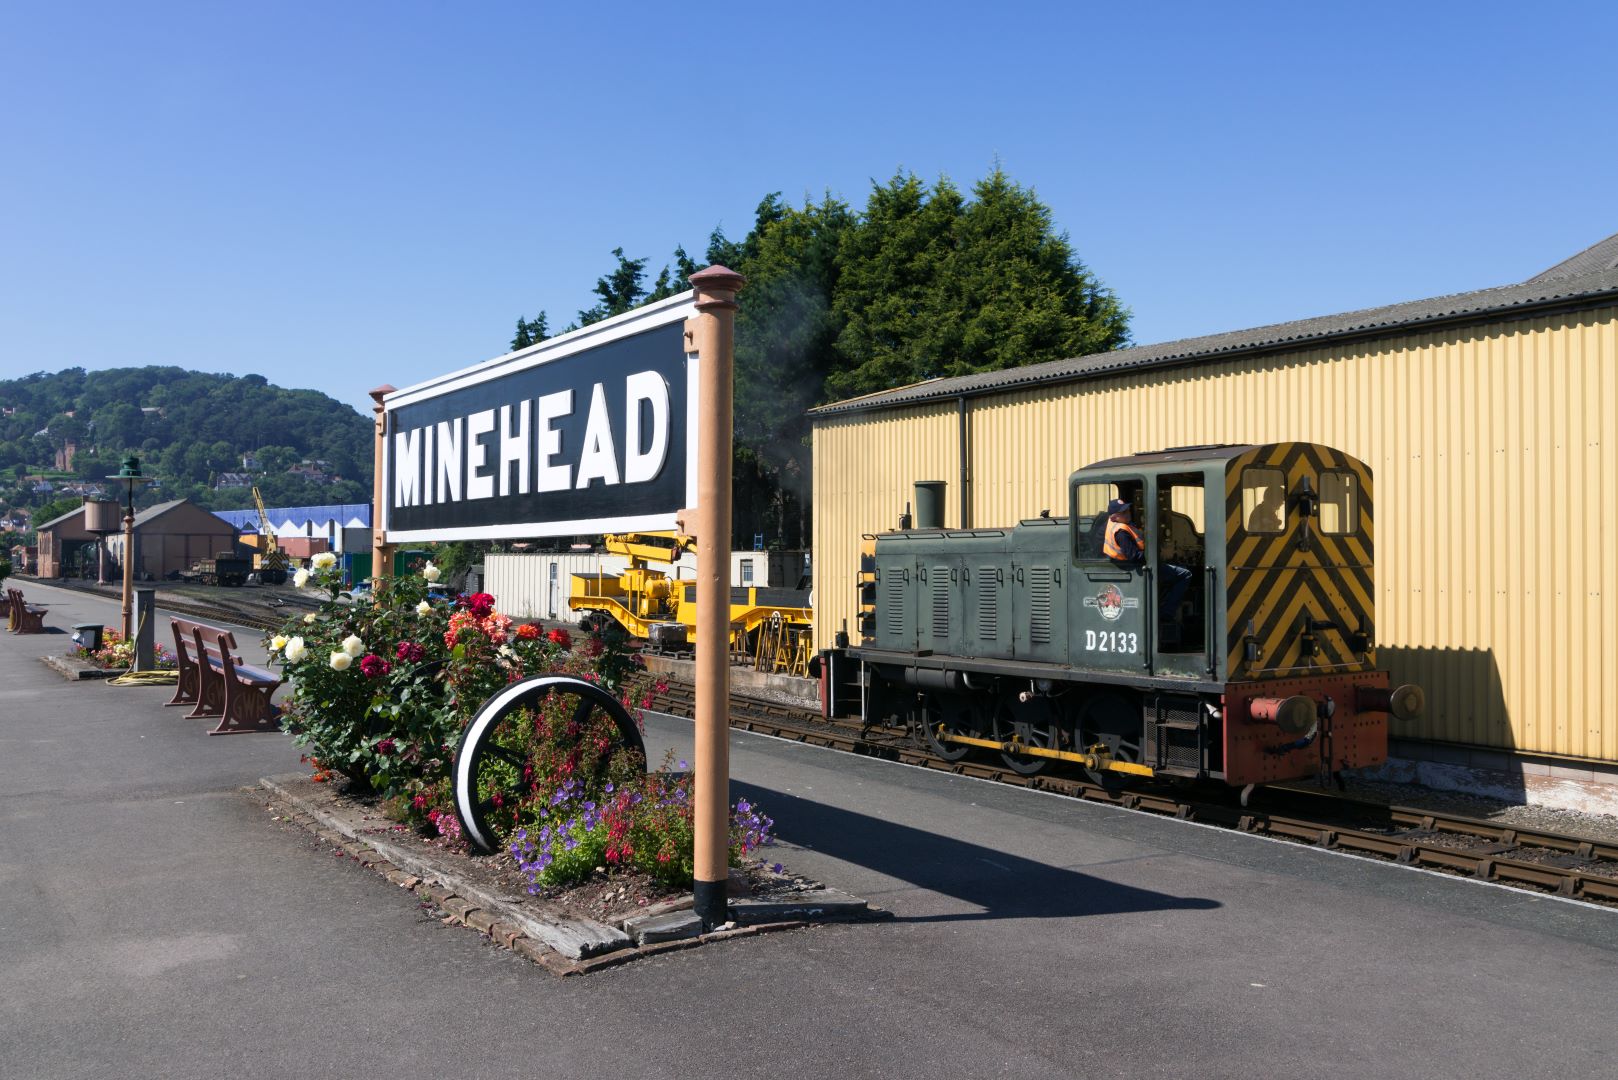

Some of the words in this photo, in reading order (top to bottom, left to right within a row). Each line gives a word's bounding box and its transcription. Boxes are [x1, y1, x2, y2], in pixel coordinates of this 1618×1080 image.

[395, 370, 670, 508] MINEHEAD
[1085, 630, 1138, 654] D2133
[232, 691, 267, 722] GWR
